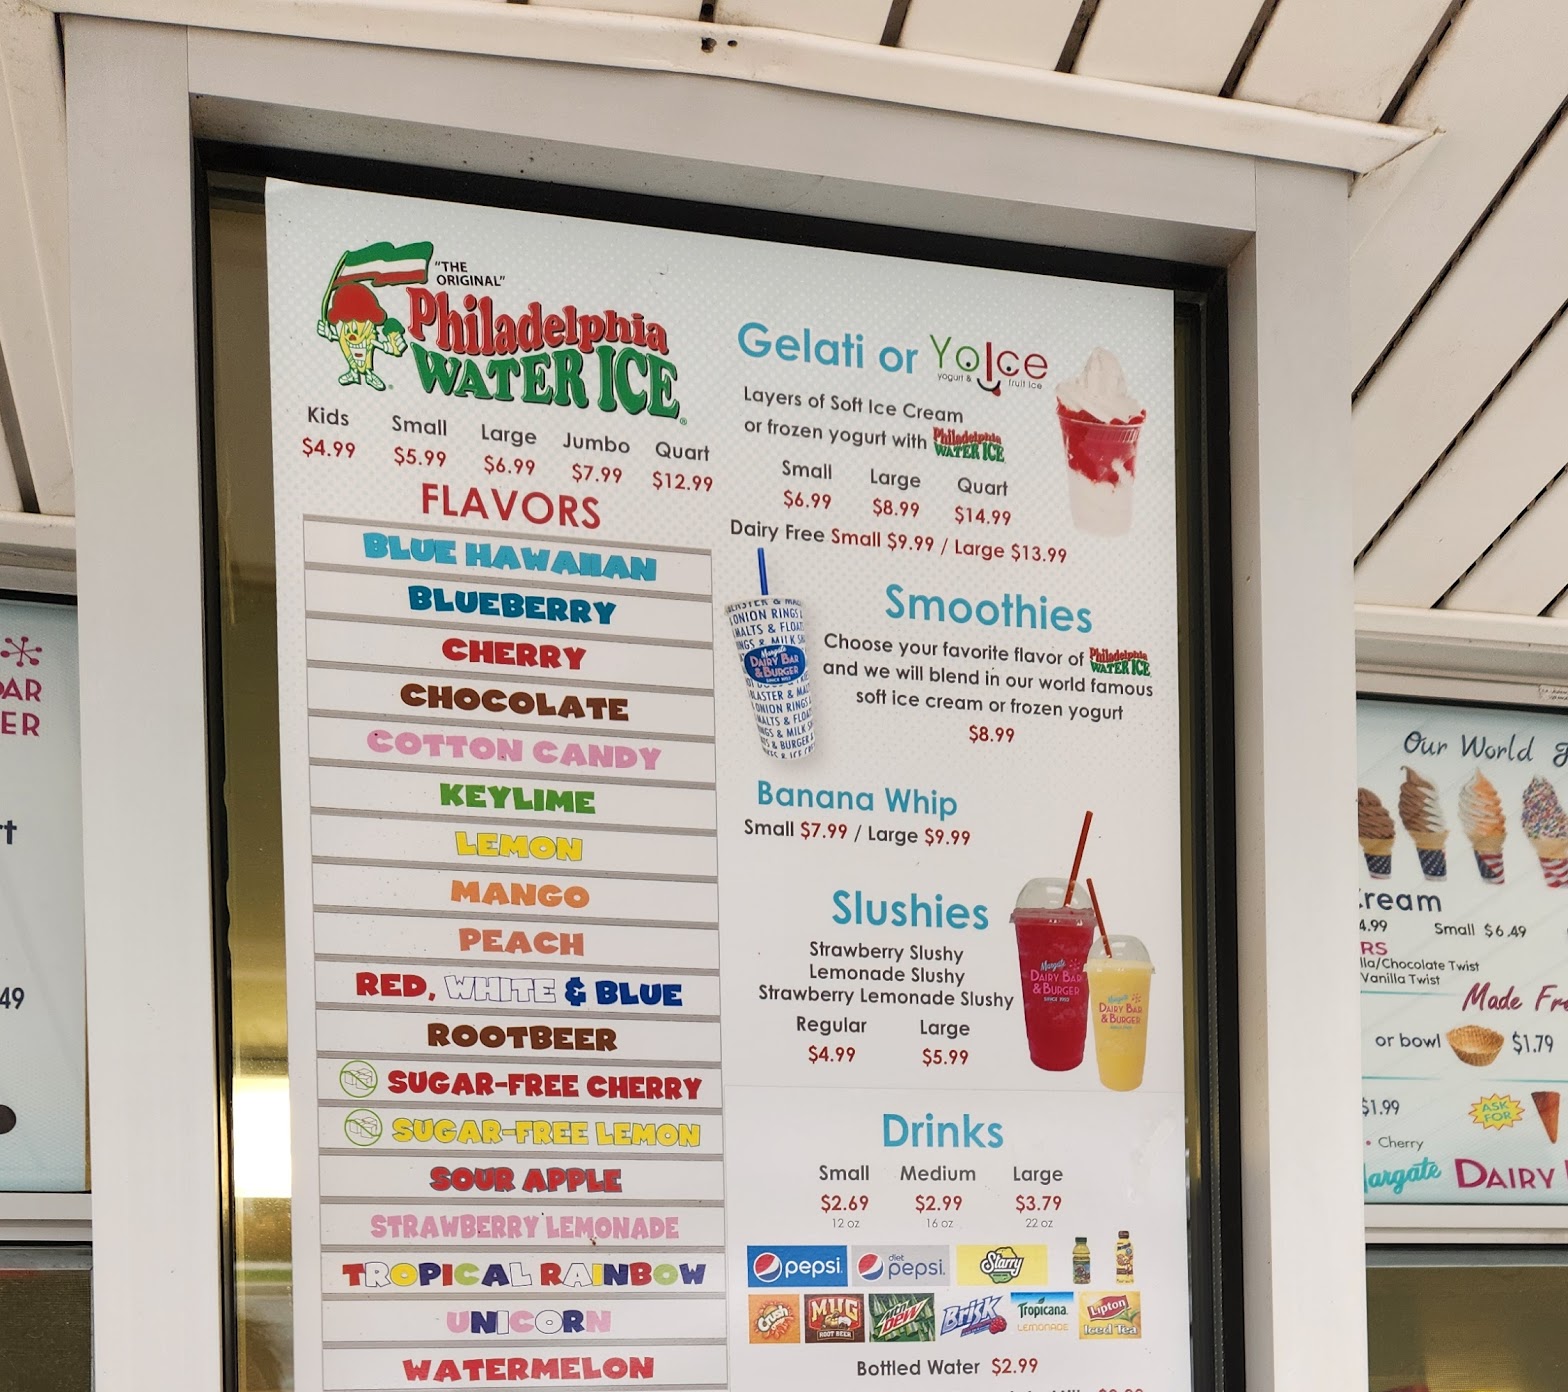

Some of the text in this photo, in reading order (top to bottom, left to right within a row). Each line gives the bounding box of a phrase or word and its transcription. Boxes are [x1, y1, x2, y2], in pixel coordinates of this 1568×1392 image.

[406, 287, 669, 355] Philadelphia
[738, 322, 864, 368] Gelati
[879, 346, 918, 374] or
[410, 342, 679, 419] WATER ICE
[937, 373, 972, 382] yogurt &
[1008, 379, 1025, 387] fruit
[744, 386, 964, 423] Layers of Soft Ice Cream
[307, 406, 710, 462] Kids Small Large Jumbo Quart
[302, 438, 713, 492] $4.99 $5.99 $6.99 $7.99 $12.99
[782, 460, 1008, 497] Small Large Quart
[422, 483, 601, 529] FLAVORS
[783, 490, 1011, 527] $6.99 $8.99 $14.99
[363, 532, 657, 581] BLUE HAWAIIAN
[408, 585, 616, 624] BLUEBERRY
[885, 583, 1093, 634] Smoothies
[442, 638, 586, 670] CHERRY
[400, 683, 629, 721] CHOCOLATE
[968, 725, 1015, 744] $8.99
[1403, 731, 1535, 762] Our World
[366, 729, 662, 770] COTTON CANDY
[440, 783, 596, 814] KEYLIME
[757, 780, 958, 821] Banana Whip
[455, 832, 583, 862] LEMON
[451, 880, 590, 908] MANGO
[832, 889, 989, 930] Slushies
[459, 928, 584, 956] PEACH
[1434, 922, 1475, 936] Small
[356, 971, 683, 1006] RED, WHITE & BLUE
[1360, 972, 1440, 985] Vanilla Twist
[758, 984, 1014, 1011] Strawberry Lemonade Slushy
[1461, 981, 1523, 1012] Made
[427, 1023, 618, 1051] ROOTBEER
[1375, 1031, 1554, 1055] or bowl $1.79
[387, 1070, 703, 1100] SUGAR-FREE CHERRY
[1481, 1101, 1508, 1112] ASK
[1484, 1111, 1511, 1122] FOR
[392, 1118, 701, 1147] SUGAR-FREE LEMON
[882, 1113, 1004, 1149] Drinks
[1378, 1136, 1424, 1152] Cherry
[429, 1166, 622, 1193] SOUR APPLE
[819, 1164, 1063, 1185] Small Medium Large
[1454, 1158, 1555, 1189] DAIRY
[820, 1194, 1062, 1213] $2.69 $2.99 $3.79
[370, 1214, 679, 1240] STRAWBERRY LEMONADE
[832, 1218, 860, 1229] 12 oz
[926, 1218, 954, 1229] 16 oz
[1025, 1218, 1054, 1229] 22 oz
[785, 1257, 841, 1278] pepsi
[889, 1254, 905, 1262] diet
[981, 1251, 1025, 1277] Starry
[342, 1262, 706, 1287] TROPICAL RAINBOW
[811, 1298, 859, 1321] MUG
[1017, 1302, 1067, 1318] Tropicana
[1089, 1297, 1126, 1316] Lipton
[446, 1310, 611, 1335] UNICORN
[1017, 1323, 1069, 1331] LEMONADE
[1084, 1324, 1137, 1335] Iced Tea
[402, 1356, 654, 1382] WATERMELON
[857, 1357, 1038, 1377] Bottled Water $2.99
